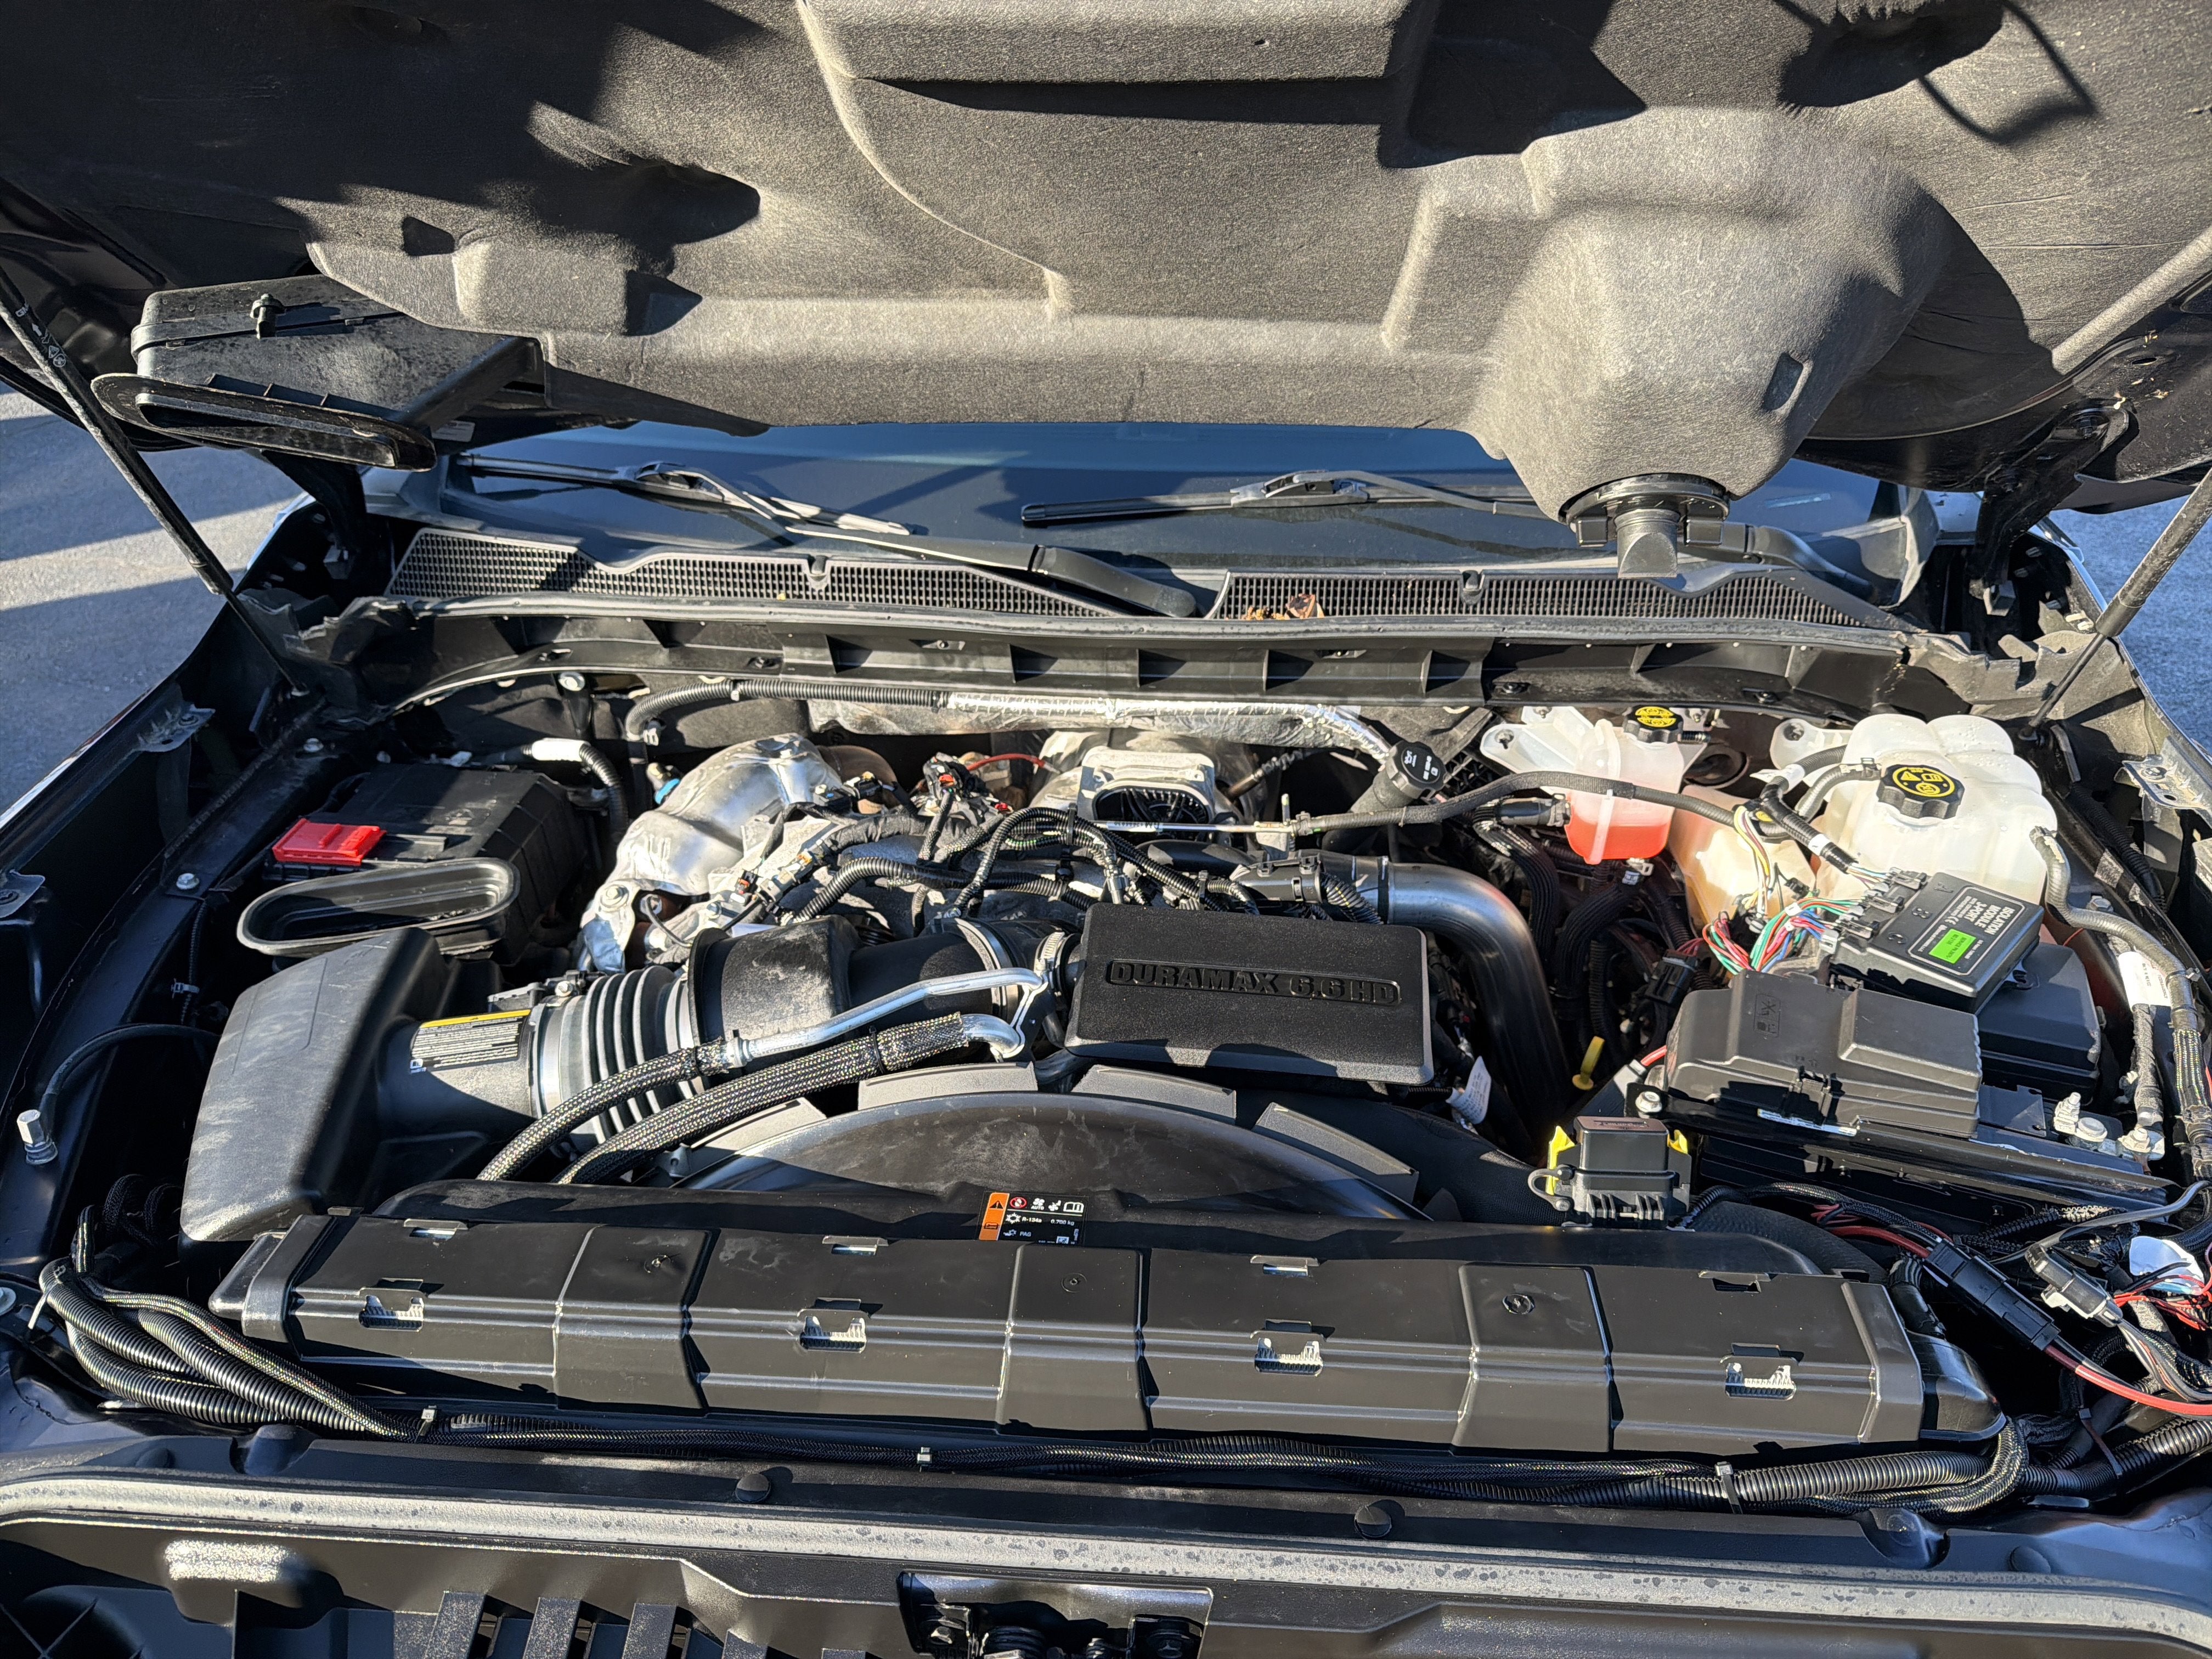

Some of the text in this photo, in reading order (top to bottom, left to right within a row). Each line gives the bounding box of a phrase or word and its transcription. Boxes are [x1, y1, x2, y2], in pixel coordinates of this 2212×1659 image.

[1963, 901, 1988, 922] 3-PORT
[1974, 905, 2002, 928] MODULE
[1984, 906, 2016, 935] ISOLATION
[1113, 962, 1279, 994] DURAMAX
